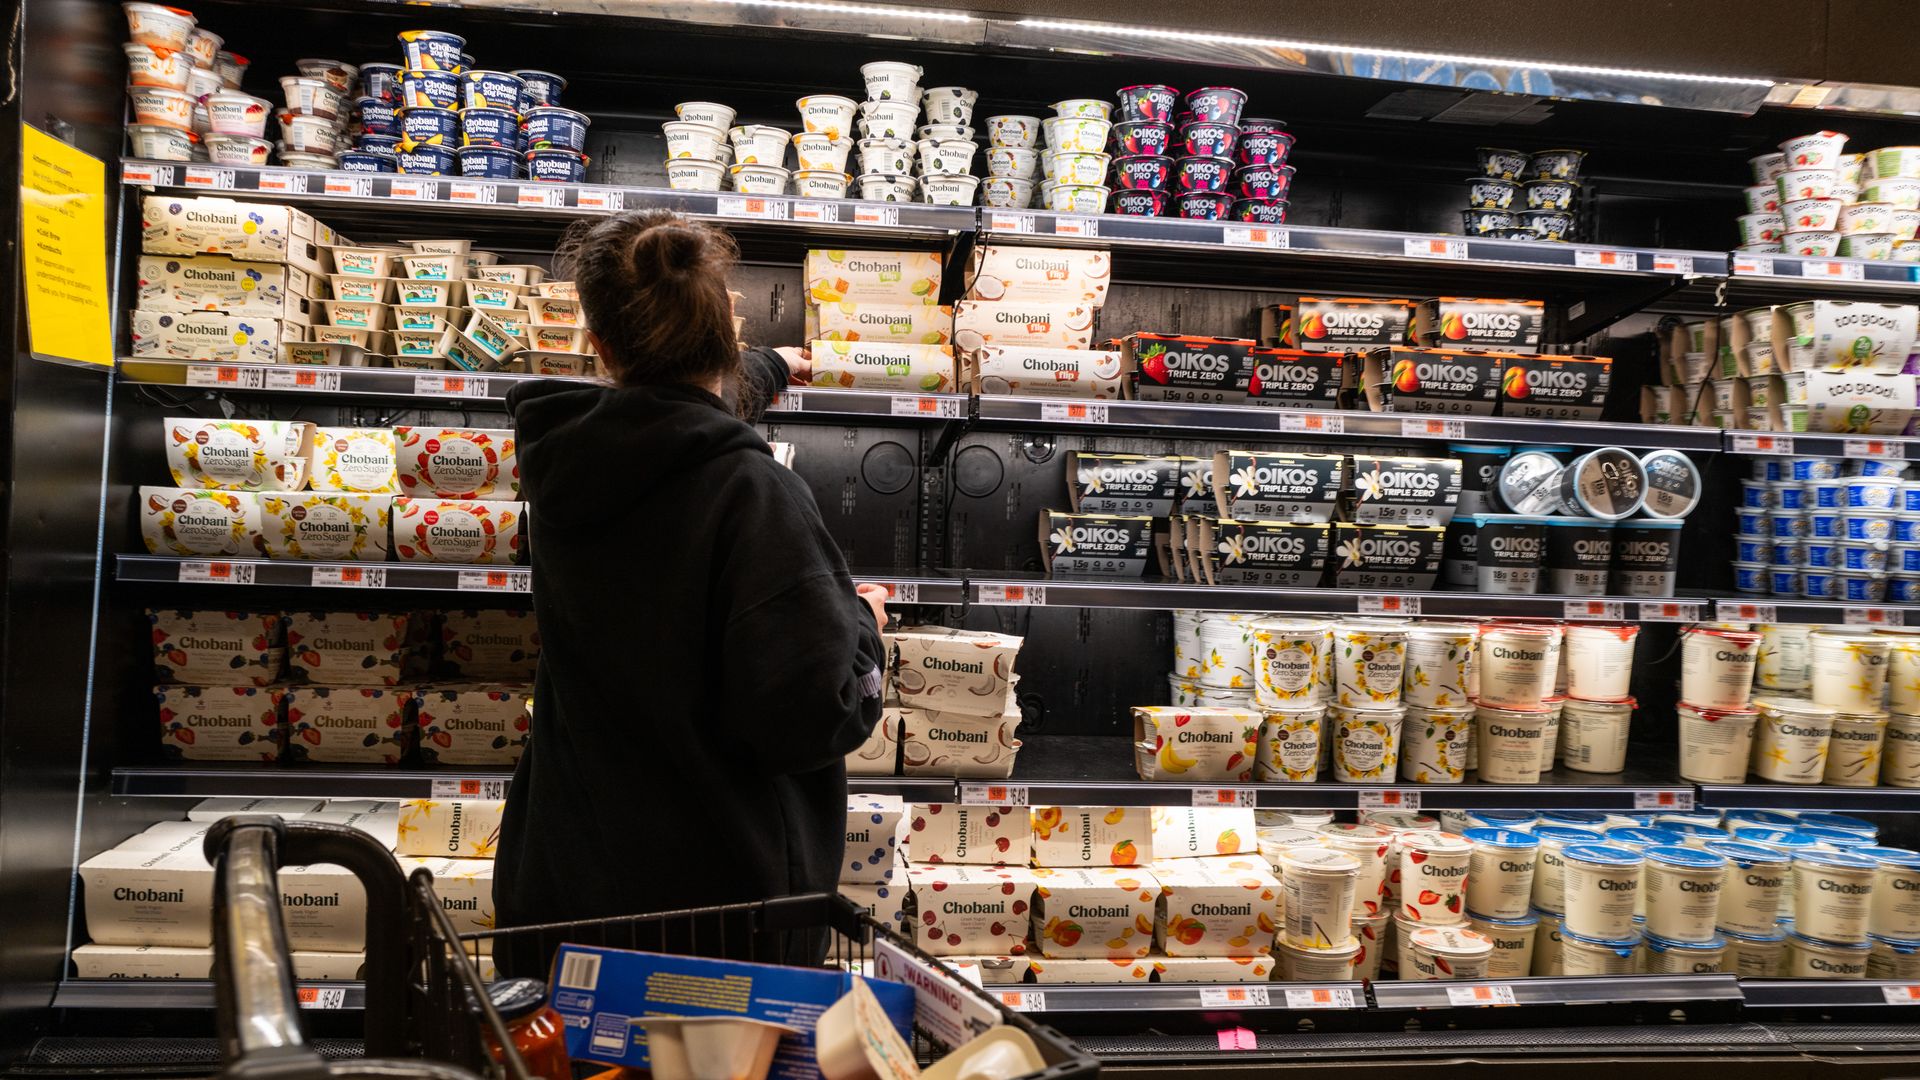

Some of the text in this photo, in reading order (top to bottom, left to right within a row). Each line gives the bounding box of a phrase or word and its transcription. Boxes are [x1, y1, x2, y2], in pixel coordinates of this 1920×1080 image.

[808, 107, 839, 115] Chobani
[415, 124, 438, 132] Protein
[476, 126, 499, 134] Protein
[1133, 128, 1166, 140] OIKOS
[1190, 129, 1224, 140] OIKOS
[1142, 137, 1157, 146] PRO
[1197, 137, 1214, 146] PRO
[1244, 139, 1277, 150] OIKOS
[802, 143, 833, 152] Chobani
[1251, 147, 1267, 155] PRO
[1126, 163, 1159, 174] OIKOS
[1186, 164, 1220, 175] OIKOS
[744, 175, 776, 185] Chobani
[1134, 172, 1150, 181] PRO
[1194, 172, 1210, 181] PRO
[1245, 172, 1278, 183] OIKOS
[809, 180, 840, 191] Chobani
[929, 184, 959, 193] Chobani
[1252, 180, 1269, 188] PRO
[1120, 197, 1153, 208] OIKOS
[1183, 199, 1216, 211] OIKOS
[1127, 205, 1143, 213] PRO
[1190, 207, 1206, 215] PRO
[1251, 204, 1283, 216] OIKOS
[186, 211, 237, 225] Chobani
[1260, 214, 1275, 222] PRO
[848, 261, 901, 274] Chobani
[1016, 258, 1069, 271] Chobani
[184, 270, 235, 281] Chobani
[882, 272, 897, 280] flip
[1050, 270, 1066, 279] flip
[859, 313, 912, 325] Chobani
[995, 312, 1050, 325] Chobani
[1322, 312, 1384, 328] OIKOS
[1462, 312, 1521, 330] OIKOS
[177, 324, 227, 336] Chobani
[893, 324, 908, 333] flip
[1031, 322, 1046, 332] flip
[1327, 327, 1380, 336] TRIPLE ZERO
[1467, 328, 1517, 338] TRIPLE ZERO
[854, 353, 910, 366] Chobani
[1023, 358, 1079, 372] Chobani
[1163, 351, 1229, 373] OIKOS
[890, 365, 906, 375] flip
[1058, 370, 1075, 380] flip
[1168, 370, 1224, 381] TRIPLE ZERO
[1256, 364, 1319, 384] OIKOS
[1415, 363, 1478, 384] OIKOS
[1526, 370, 1587, 389] OIKOS
[1261, 382, 1314, 391] TRIPLE ZERO
[1420, 381, 1474, 392] TRIPLE ZERO
[1530, 387, 1583, 398] TRIPLE ZERO
[202, 446, 249, 458] Chobani
[204, 458, 249, 469] Zero Sugar
[341, 454, 389, 465] Chobani
[433, 455, 482, 466] Chobani
[434, 466, 483, 477] Zero Sugar
[1100, 468, 1158, 484] OIKOS
[1255, 467, 1318, 485] OIKOS
[1379, 471, 1439, 490] OIKOS
[1105, 483, 1131, 491] TRIPLE
[1259, 484, 1313, 494] TRIPLE ZERO
[1384, 488, 1436, 497] TRIPLE ZERO
[178, 515, 227, 527] Chobani
[179, 526, 227, 537] Zero Sugar
[299, 522, 349, 532] Chobani
[431, 527, 480, 537] Chobani
[301, 532, 350, 542] Zero Sugar
[1073, 527, 1130, 543] OIKOS
[432, 537, 480, 548] Zero Sugar
[1104, 543, 1126, 551] ZERO
[1242, 535, 1305, 553] OIKOS
[1360, 539, 1421, 557] OIKOS
[1247, 552, 1301, 562] TRIPLE ZERO
[1364, 556, 1416, 565] TRIPLE ZERO
[1494, 551, 1519, 559] TRIPLE
[179, 636, 243, 651] Chobani
[313, 638, 375, 651] Chobani
[923, 656, 983, 674] Chobani
[1271, 660, 1310, 670] Chobani
[187, 714, 252, 728] Chobani
[314, 715, 377, 729] Chobani
[444, 719, 505, 731] Chobani
[928, 728, 988, 743] Chobani
[1178, 731, 1233, 743] Chobani
[1345, 740, 1383, 750] Chobani
[957, 810, 968, 858] Chobani
[114, 888, 184, 903] Chobani
[281, 893, 339, 907] hobani
[943, 901, 1005, 915] Chobani
[1069, 905, 1129, 918] Chobani
[1191, 903, 1251, 917] Chobani
